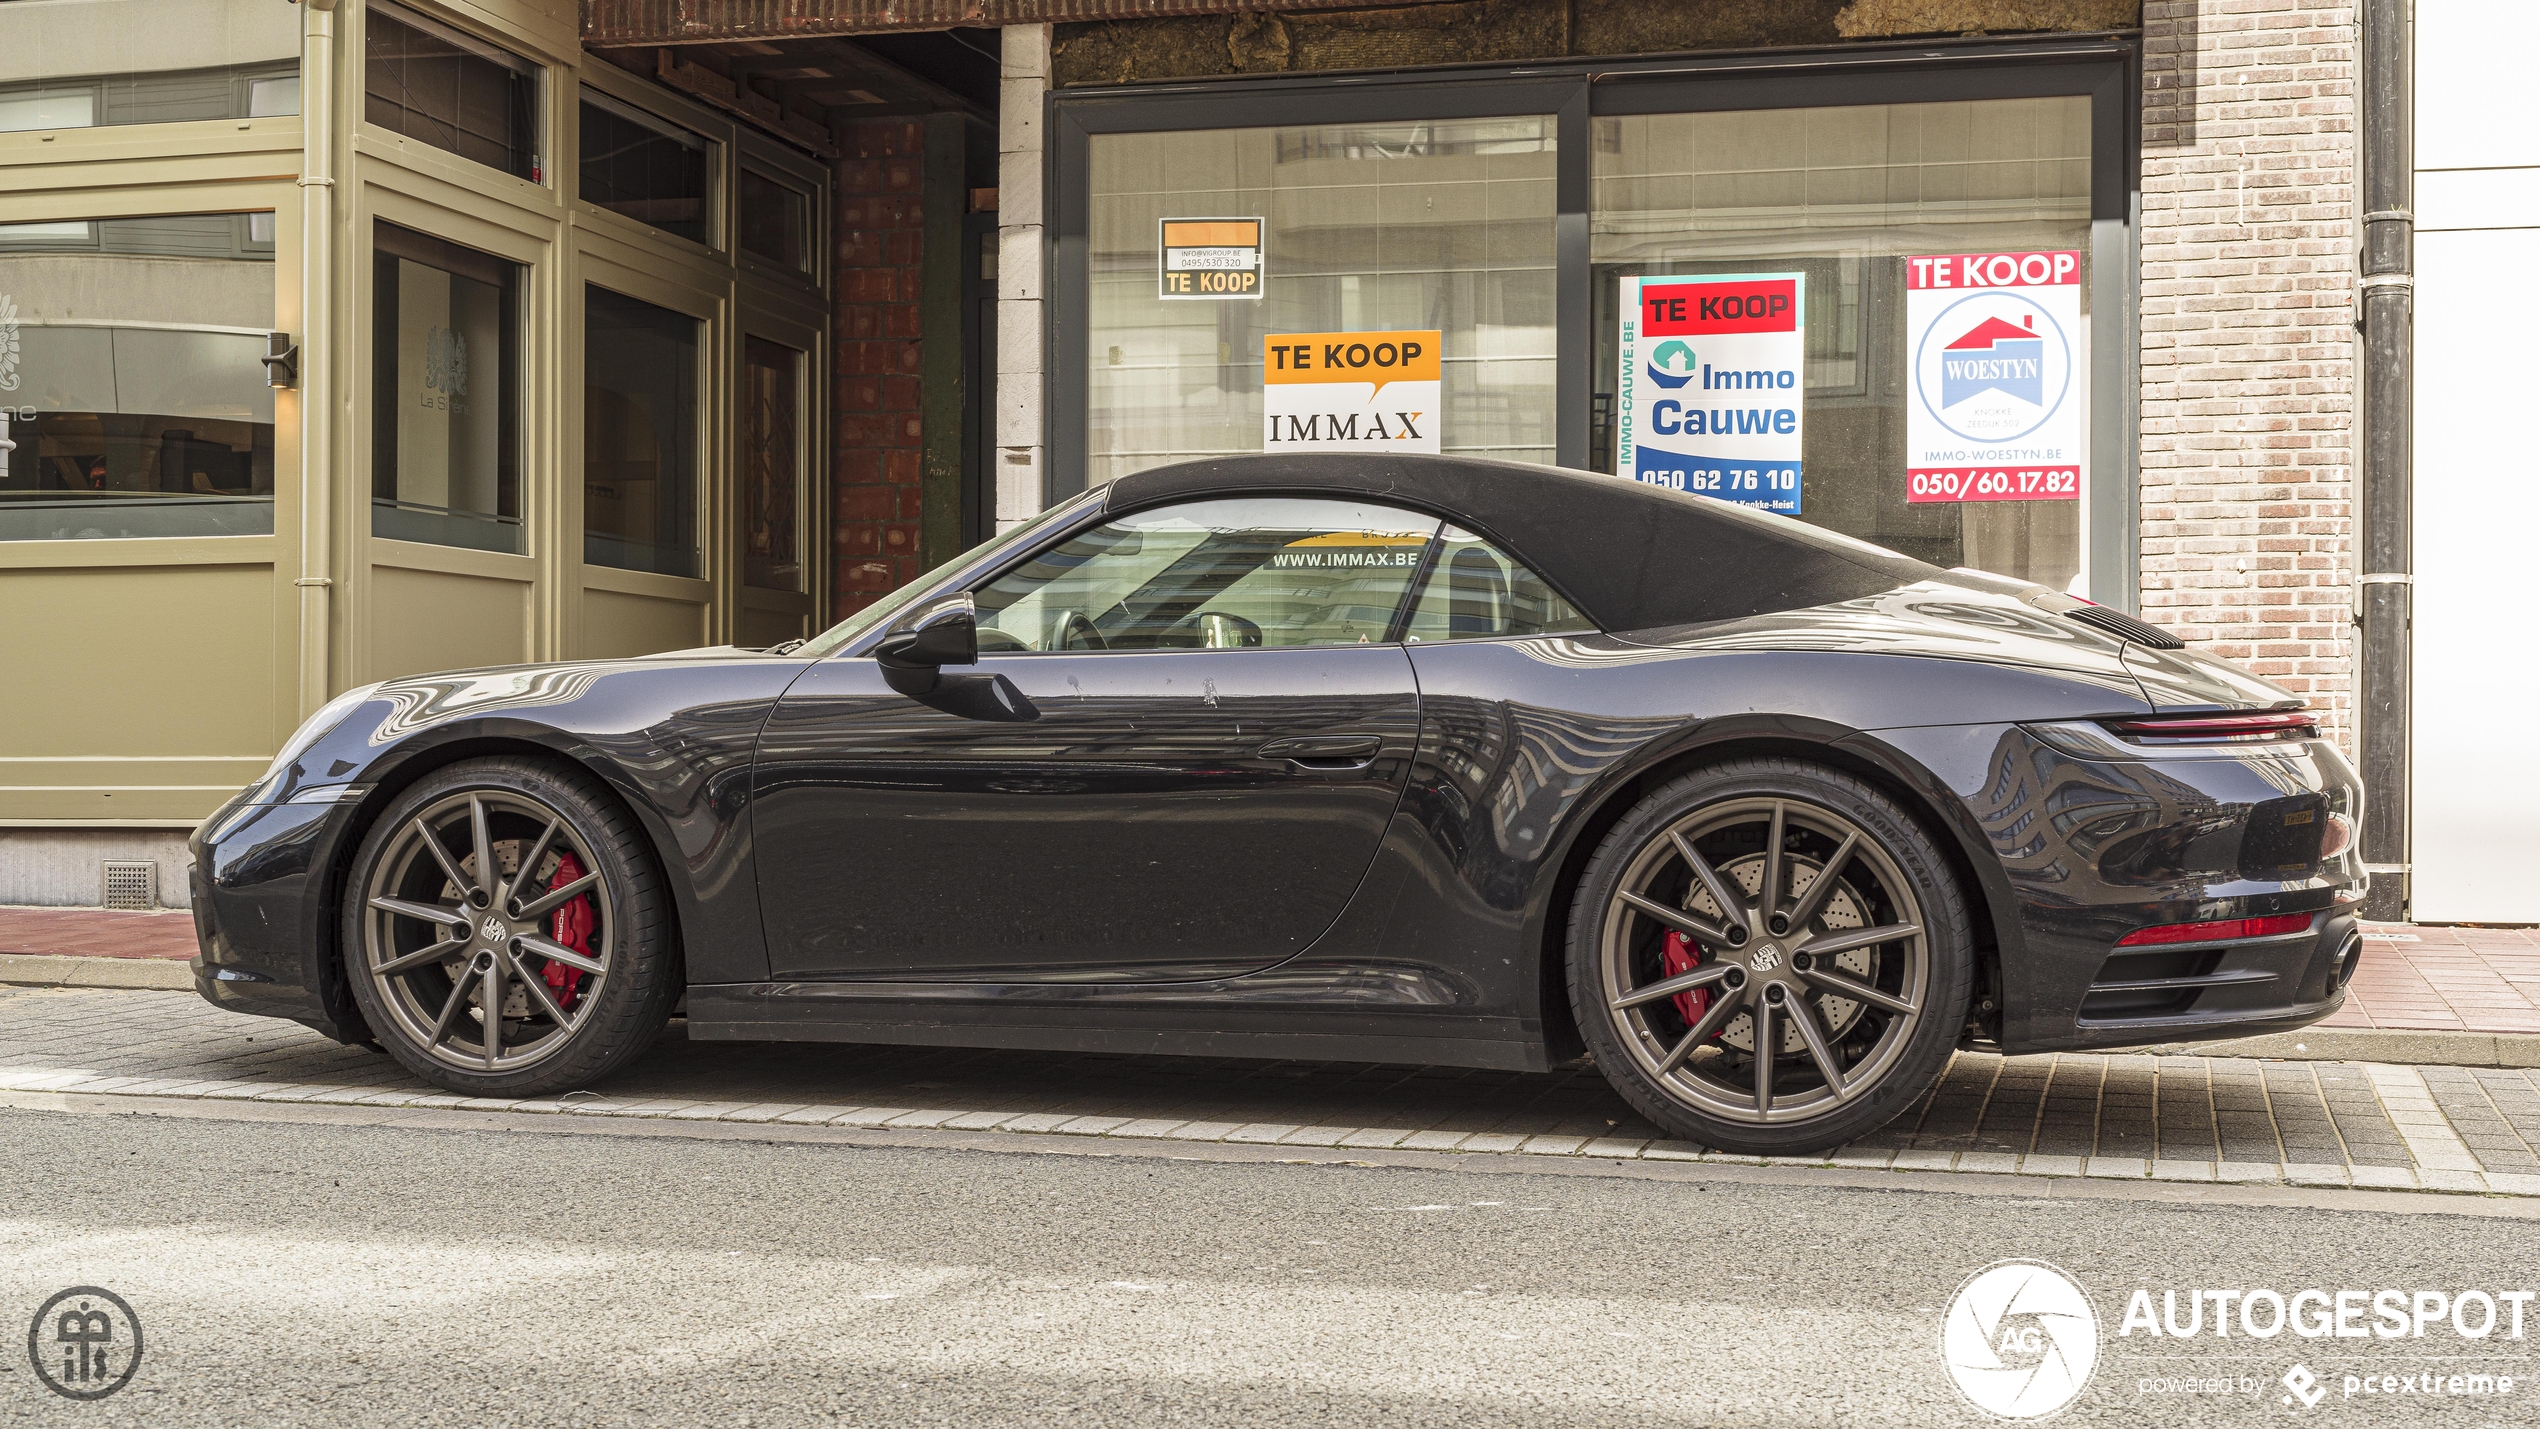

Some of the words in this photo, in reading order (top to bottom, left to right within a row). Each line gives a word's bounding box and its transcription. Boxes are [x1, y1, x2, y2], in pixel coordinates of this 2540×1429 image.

[1181, 249, 1242, 257] INFO@VIGROUP.BE
[1181, 258, 1223, 267] 0495/530
[1224, 258, 1241, 267] 320
[1913, 257, 1951, 288] TE
[1963, 253, 2075, 287] KOOP
[1166, 272, 1191, 292] TE
[1200, 272, 1256, 292] KOOP
[1650, 298, 1686, 322] TE
[1700, 294, 1788, 321] KOOP
[1271, 344, 1311, 370] TE
[1324, 342, 1422, 369] KOOP
[1703, 363, 1795, 390] Immo
[1946, 358, 2038, 380] WOESTYN
[420, 392, 434, 409] La
[1620, 321, 1635, 464] IMMO-CAUWE.BE
[1652, 399, 1796, 436] Cauwe
[1974, 407, 2013, 416] KNOKKE
[1269, 411, 1423, 442] IMMAX
[2003, 419, 2020, 428] 502
[1925, 448, 2062, 462] IMMO-WOESTYN.BE
[1692, 469, 1721, 490] 62
[1730, 469, 1758, 490] 76
[1765, 469, 1795, 490] 10
[1912, 469, 2076, 499] 050/60.17.82
[1273, 552, 1418, 567] WWW.IMMAX.BE
